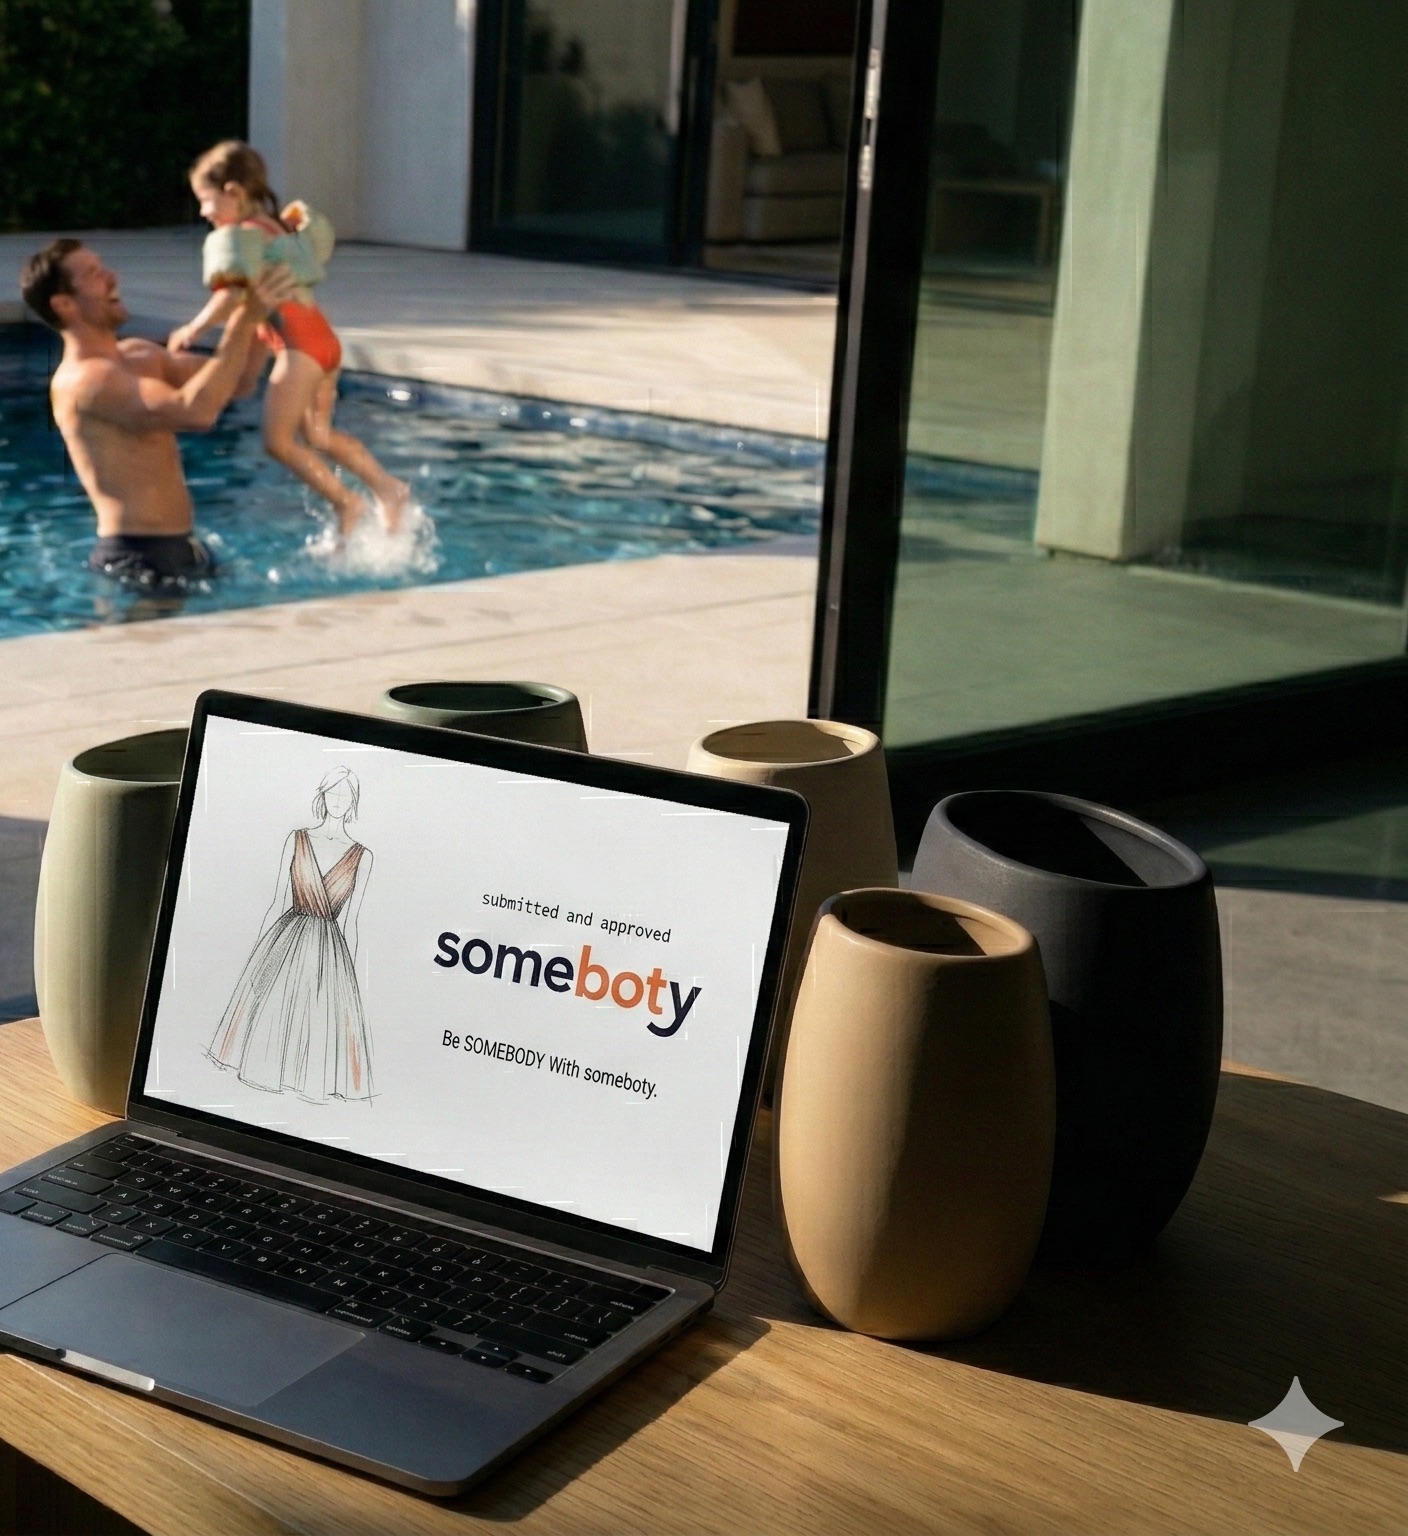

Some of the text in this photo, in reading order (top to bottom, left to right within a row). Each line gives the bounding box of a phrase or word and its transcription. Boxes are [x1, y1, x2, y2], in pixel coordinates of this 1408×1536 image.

[566, 911, 594, 927] and
[600, 918, 672, 943] approved
[433, 931, 703, 1038] someboty
[442, 1029, 658, 1100] Be SOMEBODY With someboty.
